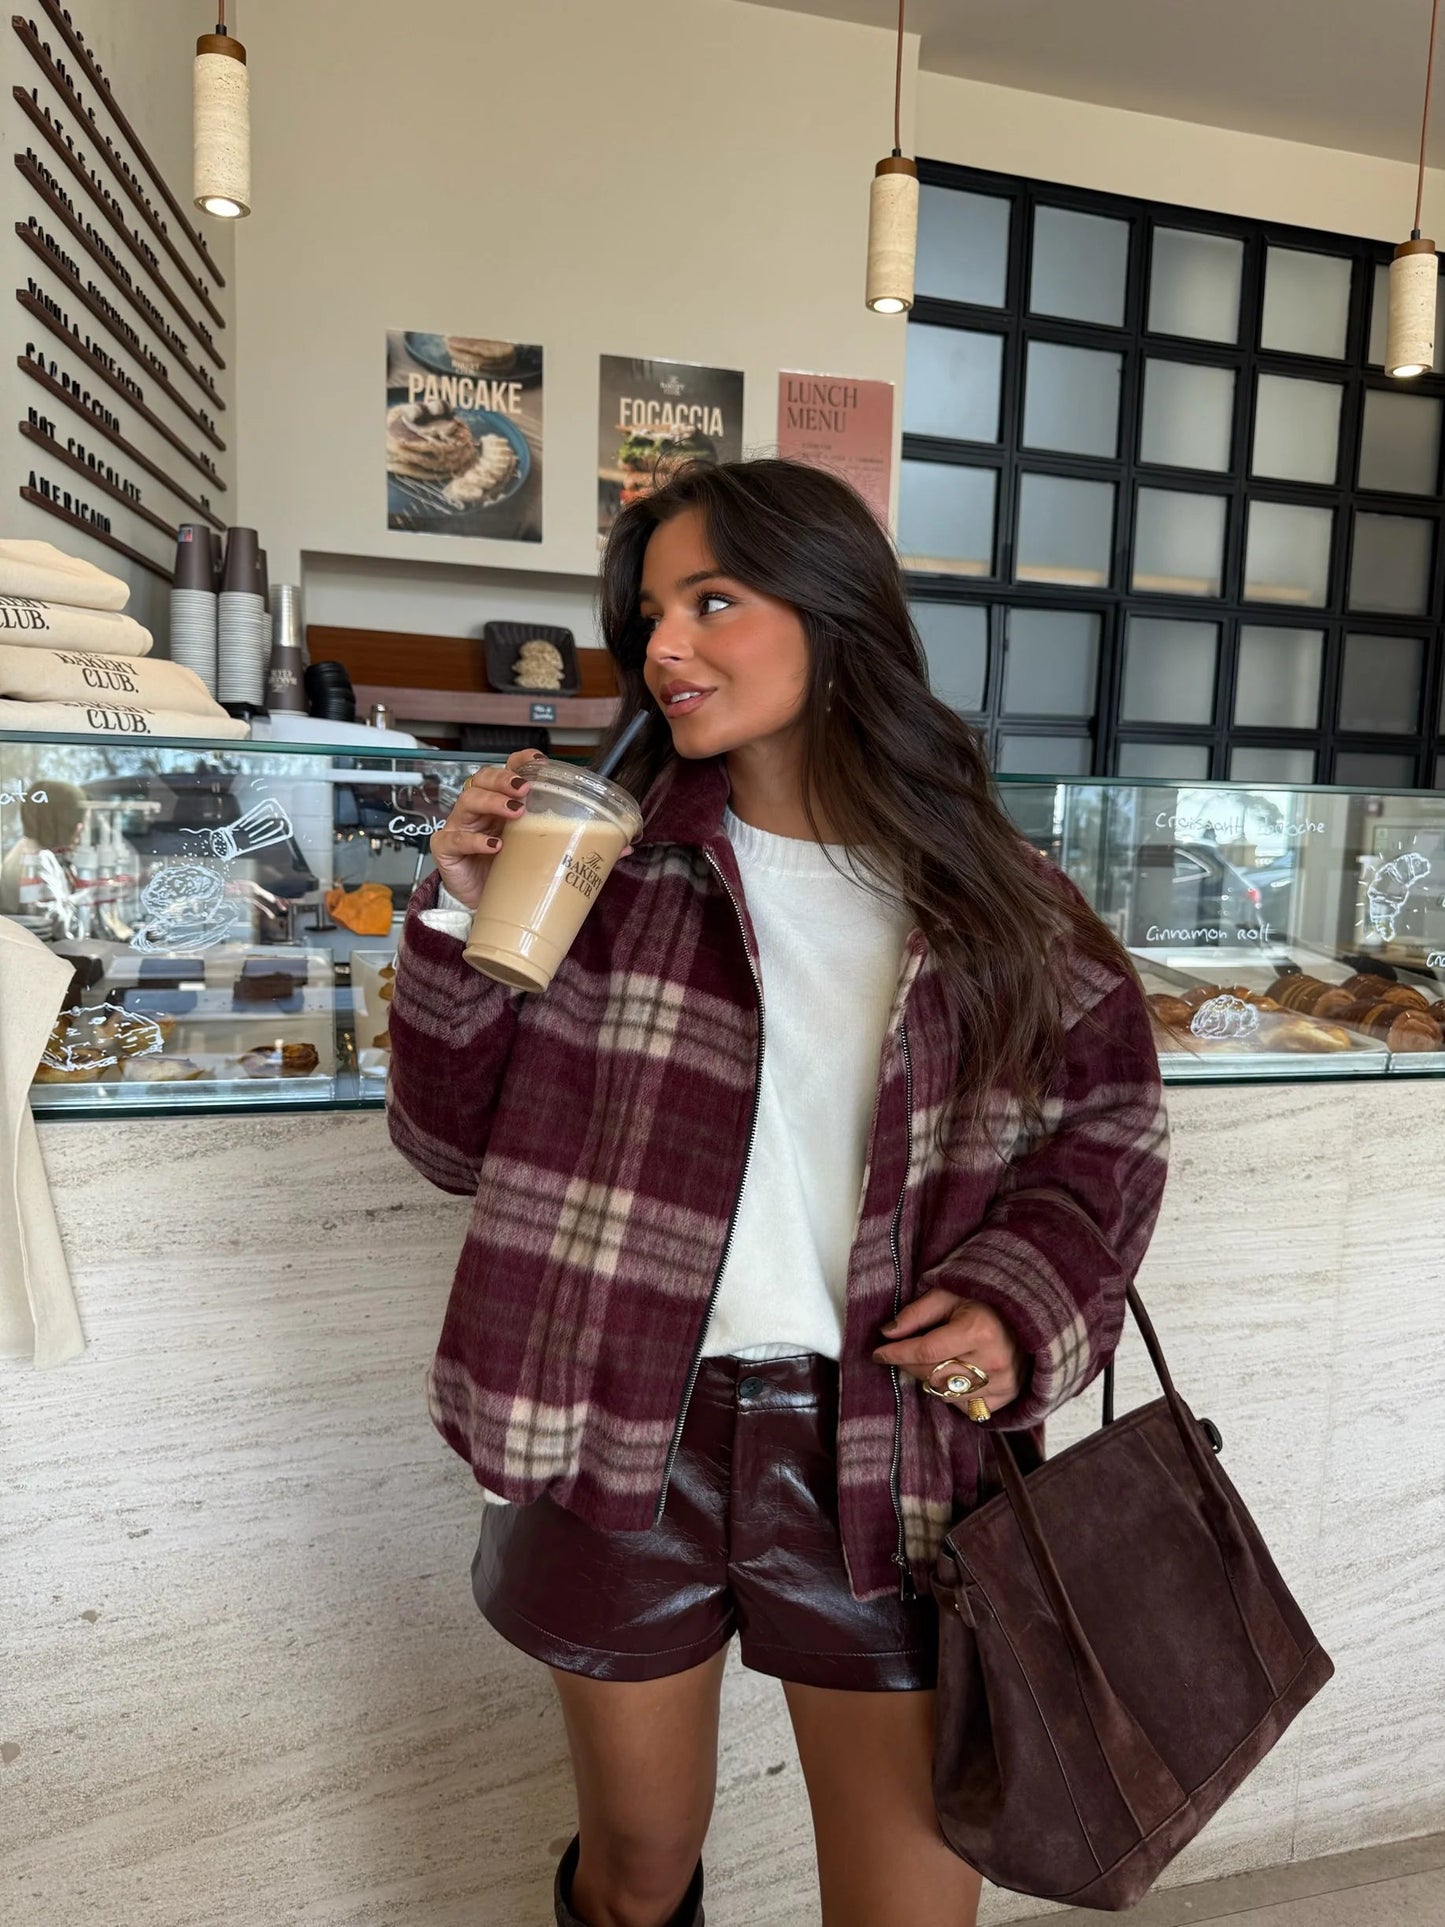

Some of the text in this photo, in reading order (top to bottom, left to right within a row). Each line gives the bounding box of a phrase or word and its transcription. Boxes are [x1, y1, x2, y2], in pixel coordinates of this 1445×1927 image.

[408, 373, 523, 414] PANCAKE
[788, 381, 858, 408] LUNCH
[620, 397, 724, 437] FOCACCIA
[787, 407, 846, 433] MENU
[28, 407, 57, 441] HOT
[67, 438, 142, 503] CHOCOLATE
[28, 470, 111, 534] AMERICANO
[0, 608, 50, 630] LUB.
[82, 667, 139, 693] CLUB.
[86, 709, 151, 734] CLUB.
[562, 854, 603, 890] BAKERY
[582, 849, 604, 871] The
[565, 871, 591, 900] CLUB.
[1146, 926, 1227, 942] Cinnamon
